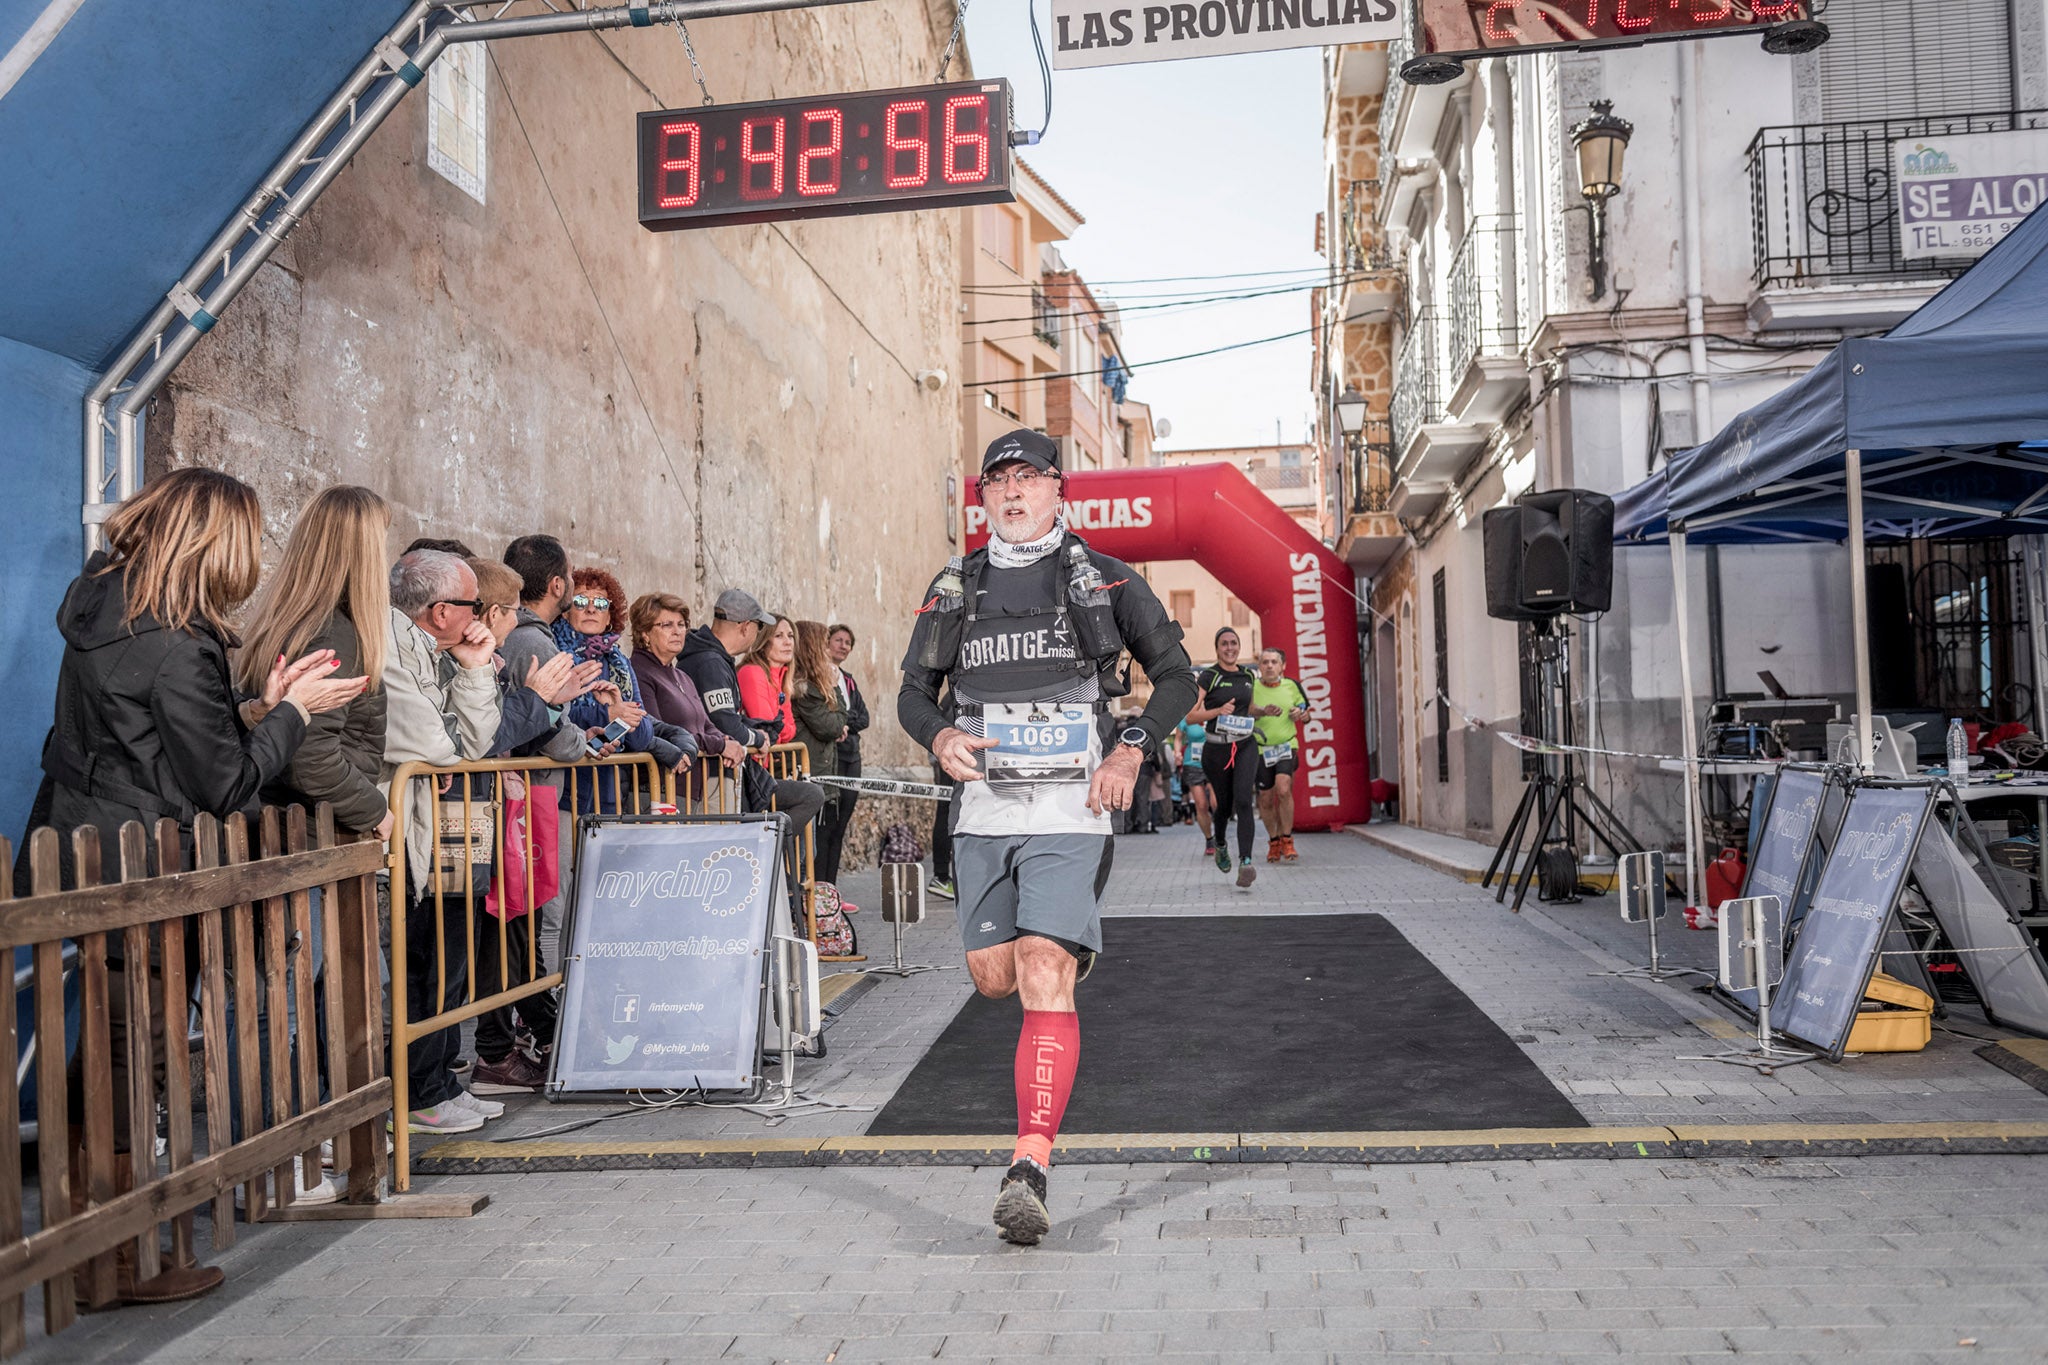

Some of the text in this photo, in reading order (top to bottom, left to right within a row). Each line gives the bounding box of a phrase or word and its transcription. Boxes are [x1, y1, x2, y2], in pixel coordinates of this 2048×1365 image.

[1056, 0, 1397, 51] LAS PROVINCIAS
[1908, 184, 1951, 218] SE
[1961, 224, 1992, 235] 651
[1962, 237, 1994, 248] 964
[961, 629, 1049, 670] CORATGE
[1289, 552, 1340, 808] LAS PROVINCIAS
[1009, 726, 1068, 746] 1069
[595, 860, 732, 907] mychip
[587, 936, 750, 961] www.mychip.es
[648, 1002, 704, 1013] /infomychip
[642, 1043, 710, 1056] @Mychip_Info
